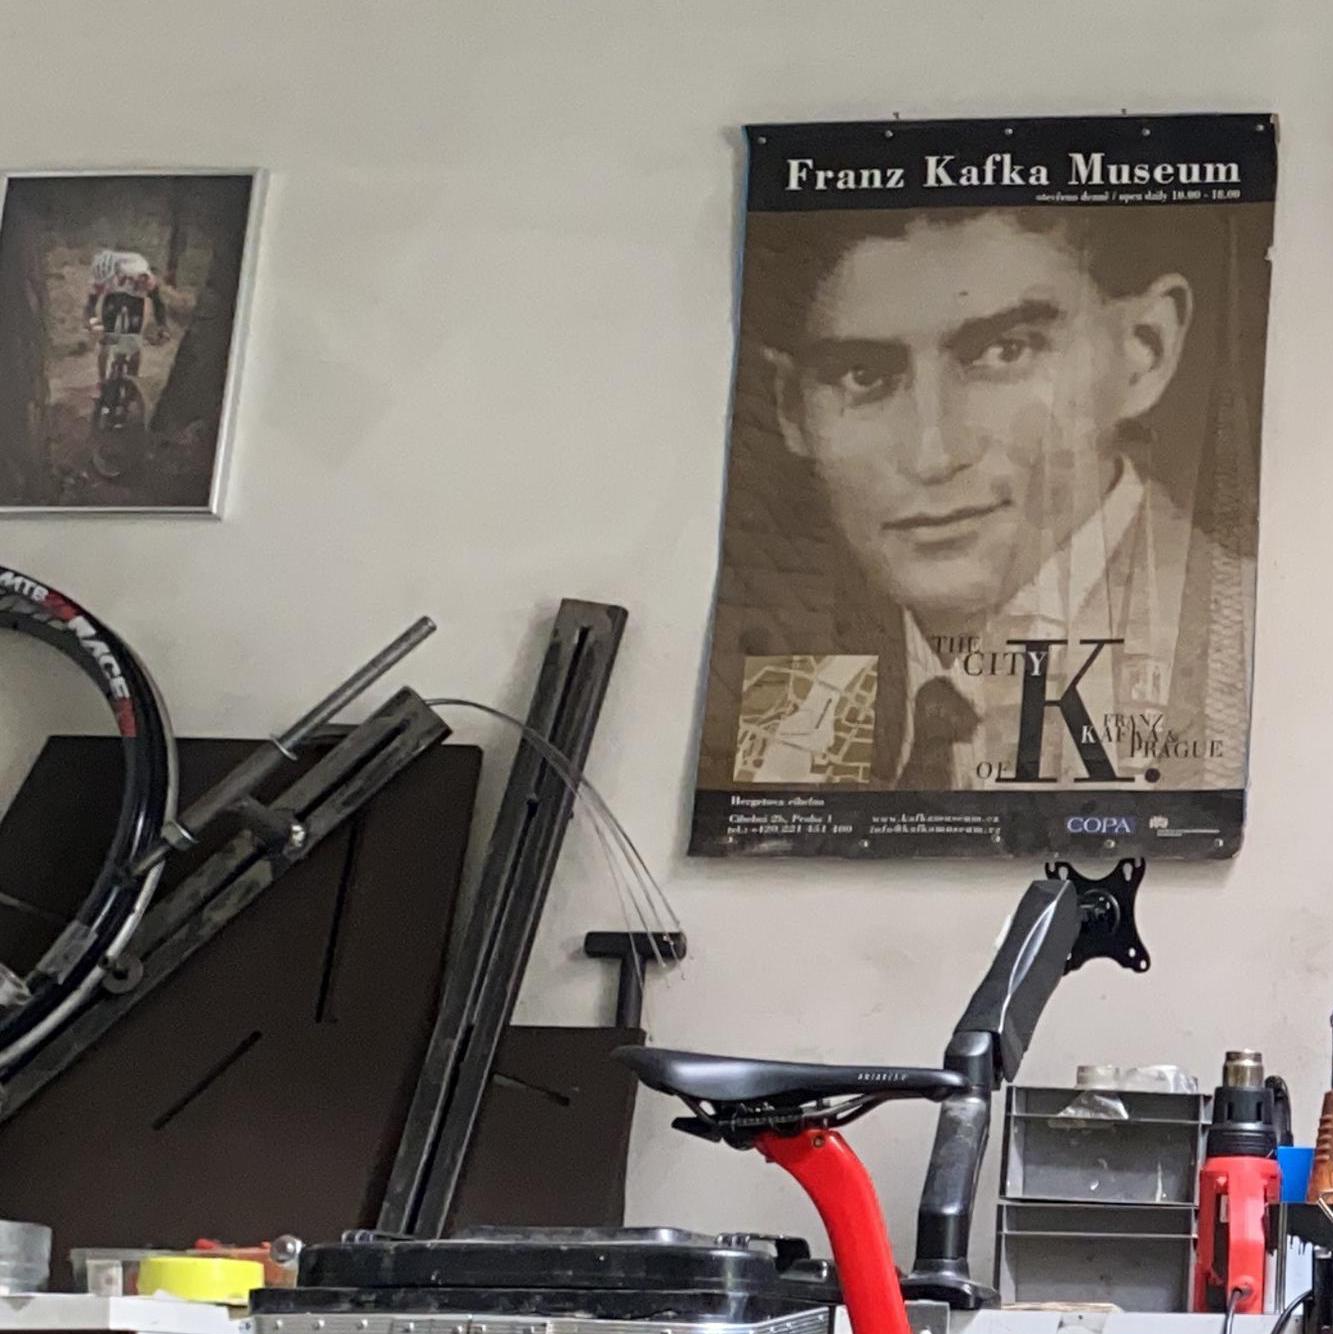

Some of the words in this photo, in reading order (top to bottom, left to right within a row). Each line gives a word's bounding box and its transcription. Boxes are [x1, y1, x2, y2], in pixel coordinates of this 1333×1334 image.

[785, 159, 905, 192] Franz
[922, 154, 1050, 188] Kafka
[1068, 153, 1241, 184] Museum
[963, 651, 1048, 677] CITY
[1103, 713, 1164, 730] FRANZ
[1129, 739, 1224, 760] PRAGUE
[1066, 816, 1132, 833] COPA
